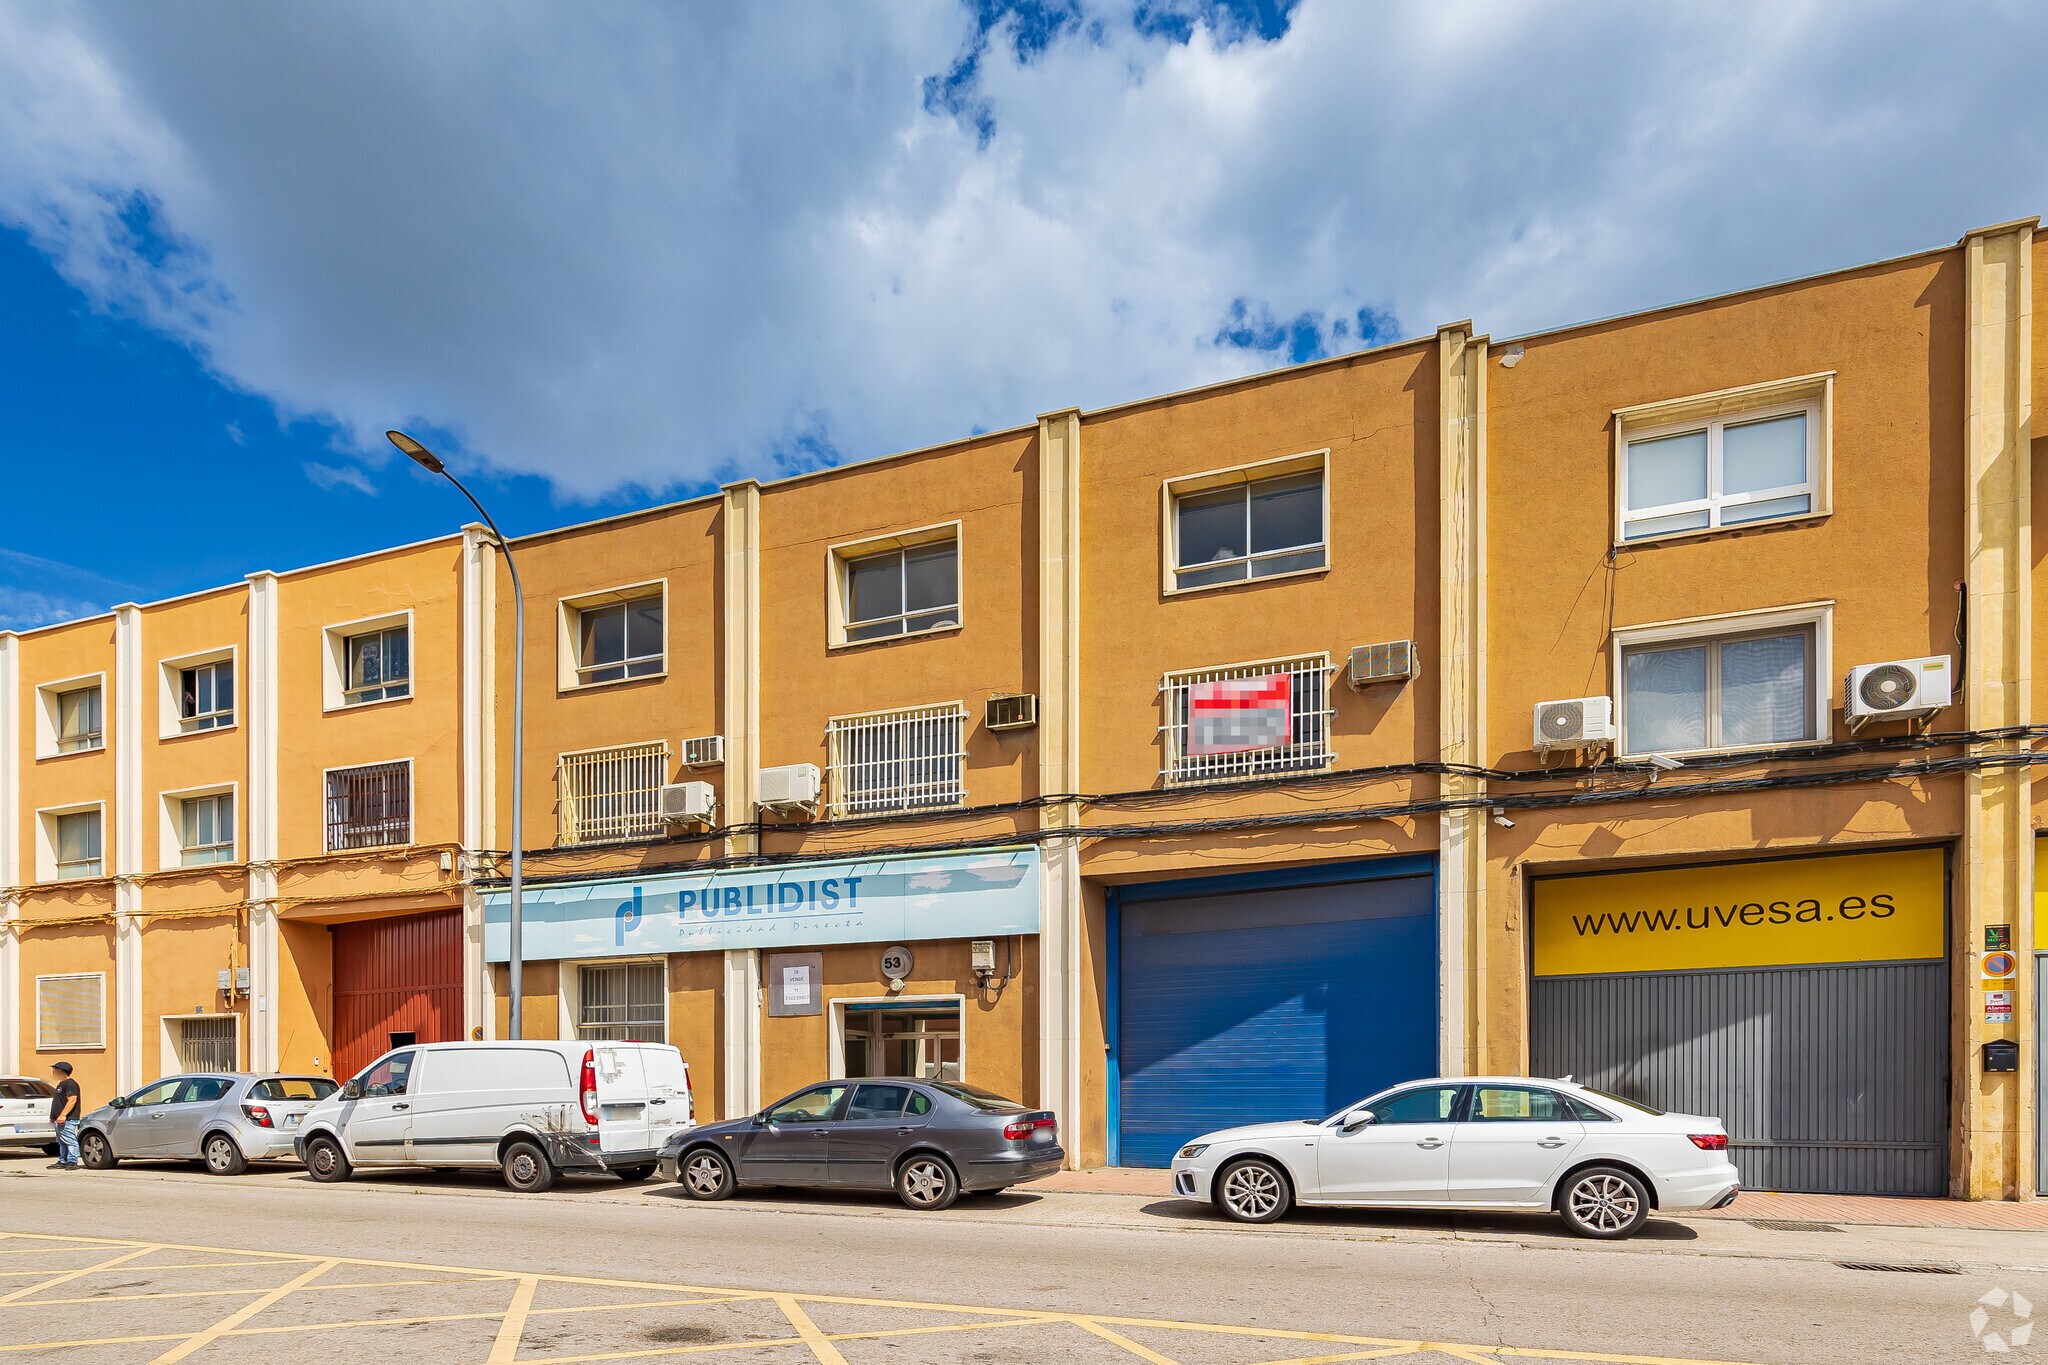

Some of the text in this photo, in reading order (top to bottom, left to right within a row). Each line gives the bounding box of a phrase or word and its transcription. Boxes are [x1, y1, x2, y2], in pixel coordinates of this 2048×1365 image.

[679, 877, 862, 919] PUBLIDIST
[678, 920, 864, 939] Publicidad Directa
[1571, 893, 1896, 936] www.uvesa.es
[884, 956, 901, 969] 53
